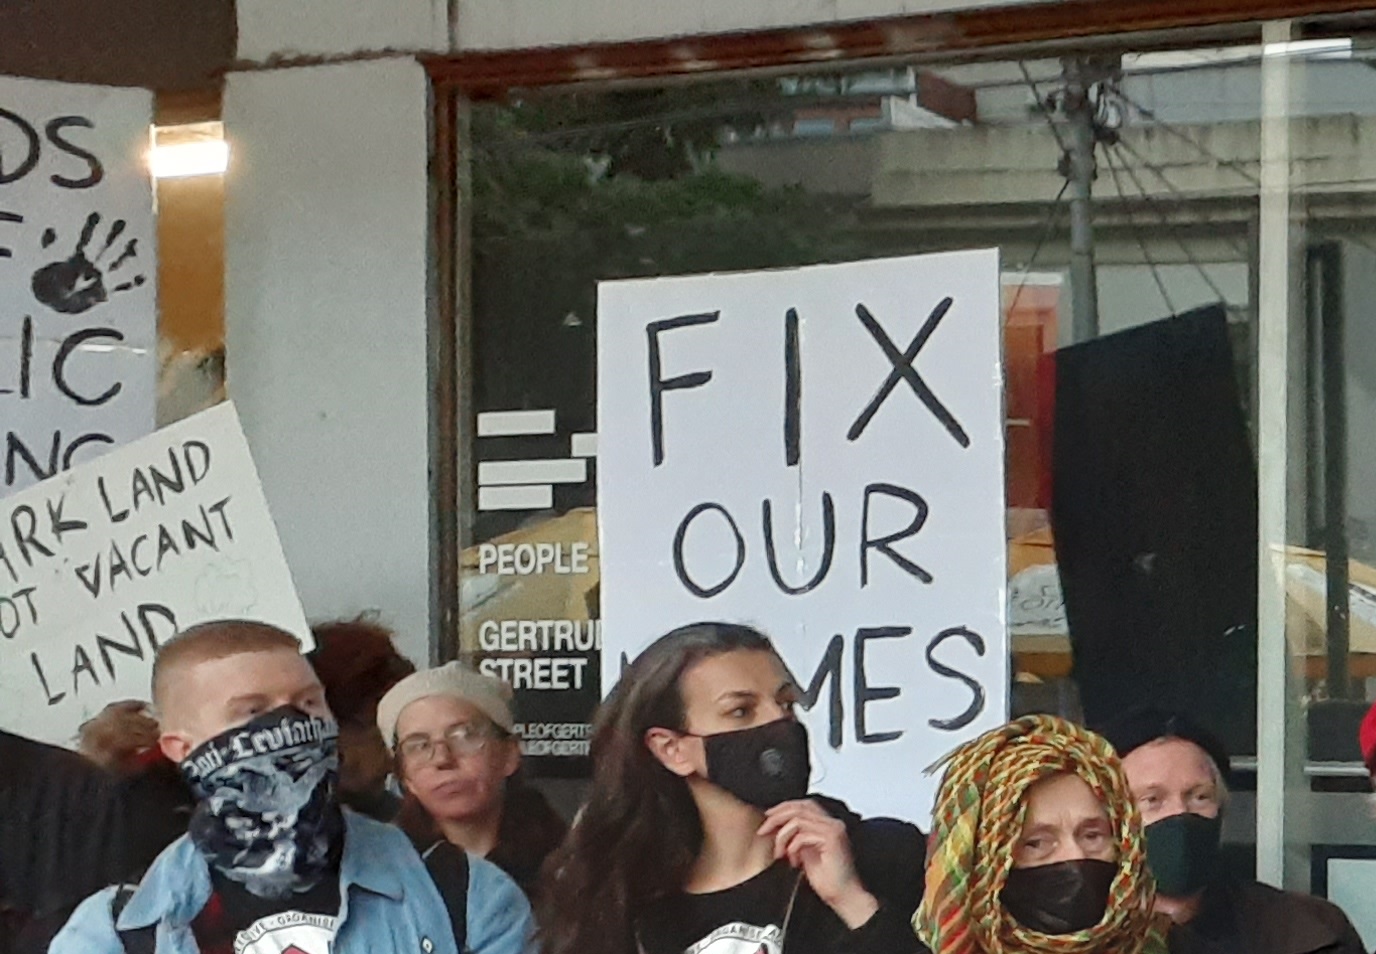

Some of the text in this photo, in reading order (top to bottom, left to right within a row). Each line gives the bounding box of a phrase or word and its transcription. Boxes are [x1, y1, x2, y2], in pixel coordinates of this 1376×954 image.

[645, 297, 970, 468] FIX
[97, 440, 211, 523] LAND
[74, 496, 233, 599] VACANT
[479, 542, 589, 575] PEOPLE
[673, 483, 934, 599] OUR
[30, 603, 179, 706] LAND
